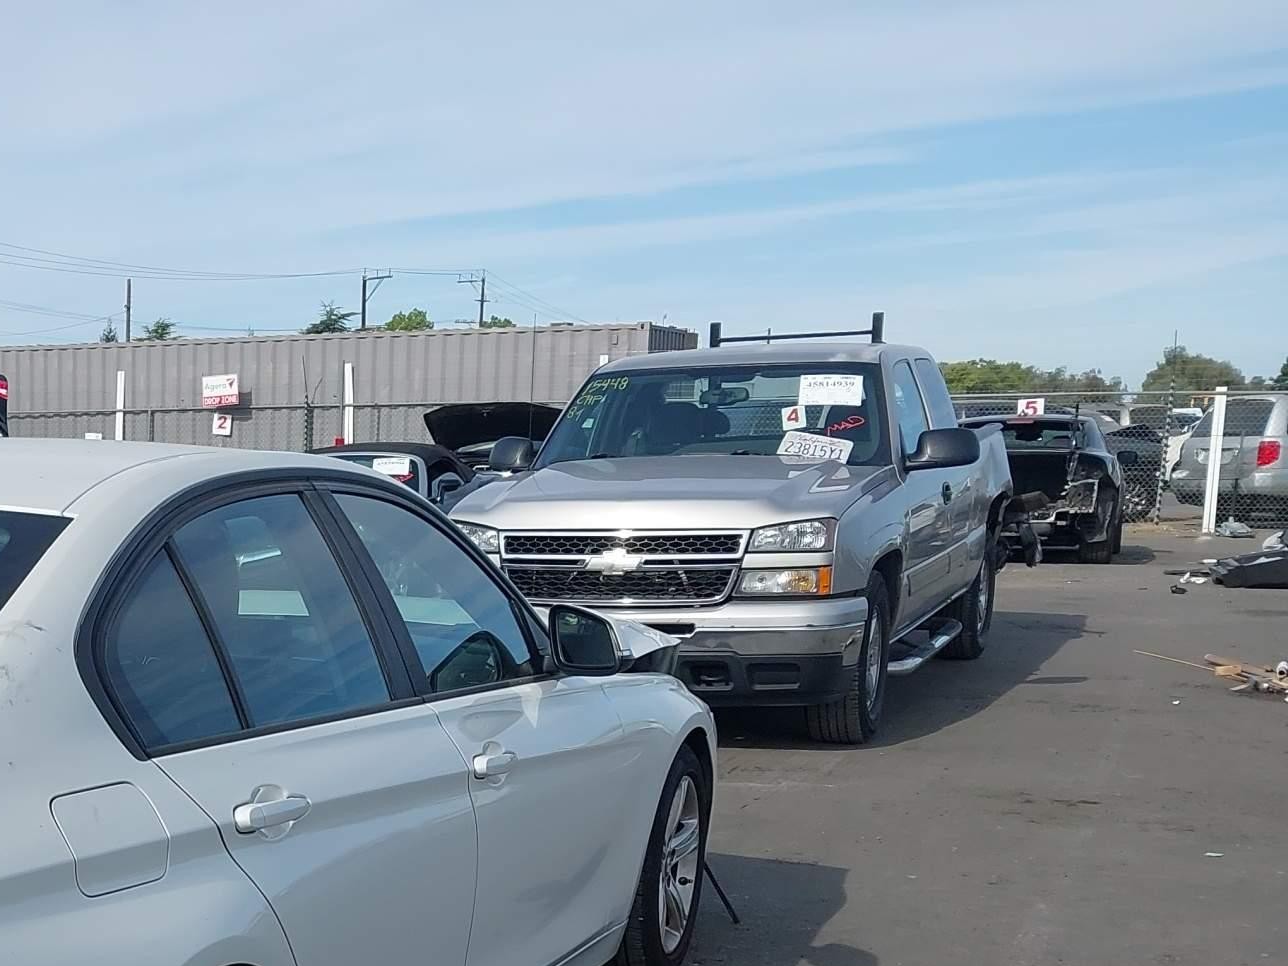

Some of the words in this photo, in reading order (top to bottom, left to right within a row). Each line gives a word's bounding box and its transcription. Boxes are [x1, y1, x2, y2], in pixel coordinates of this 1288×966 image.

[205, 397, 220, 405] DROP
[221, 395, 237, 404] ZONE
[787, 408, 799, 423] 4
[1025, 401, 1038, 416] 5
[217, 416, 228, 429] 2
[784, 440, 844, 460] 23815Y1
